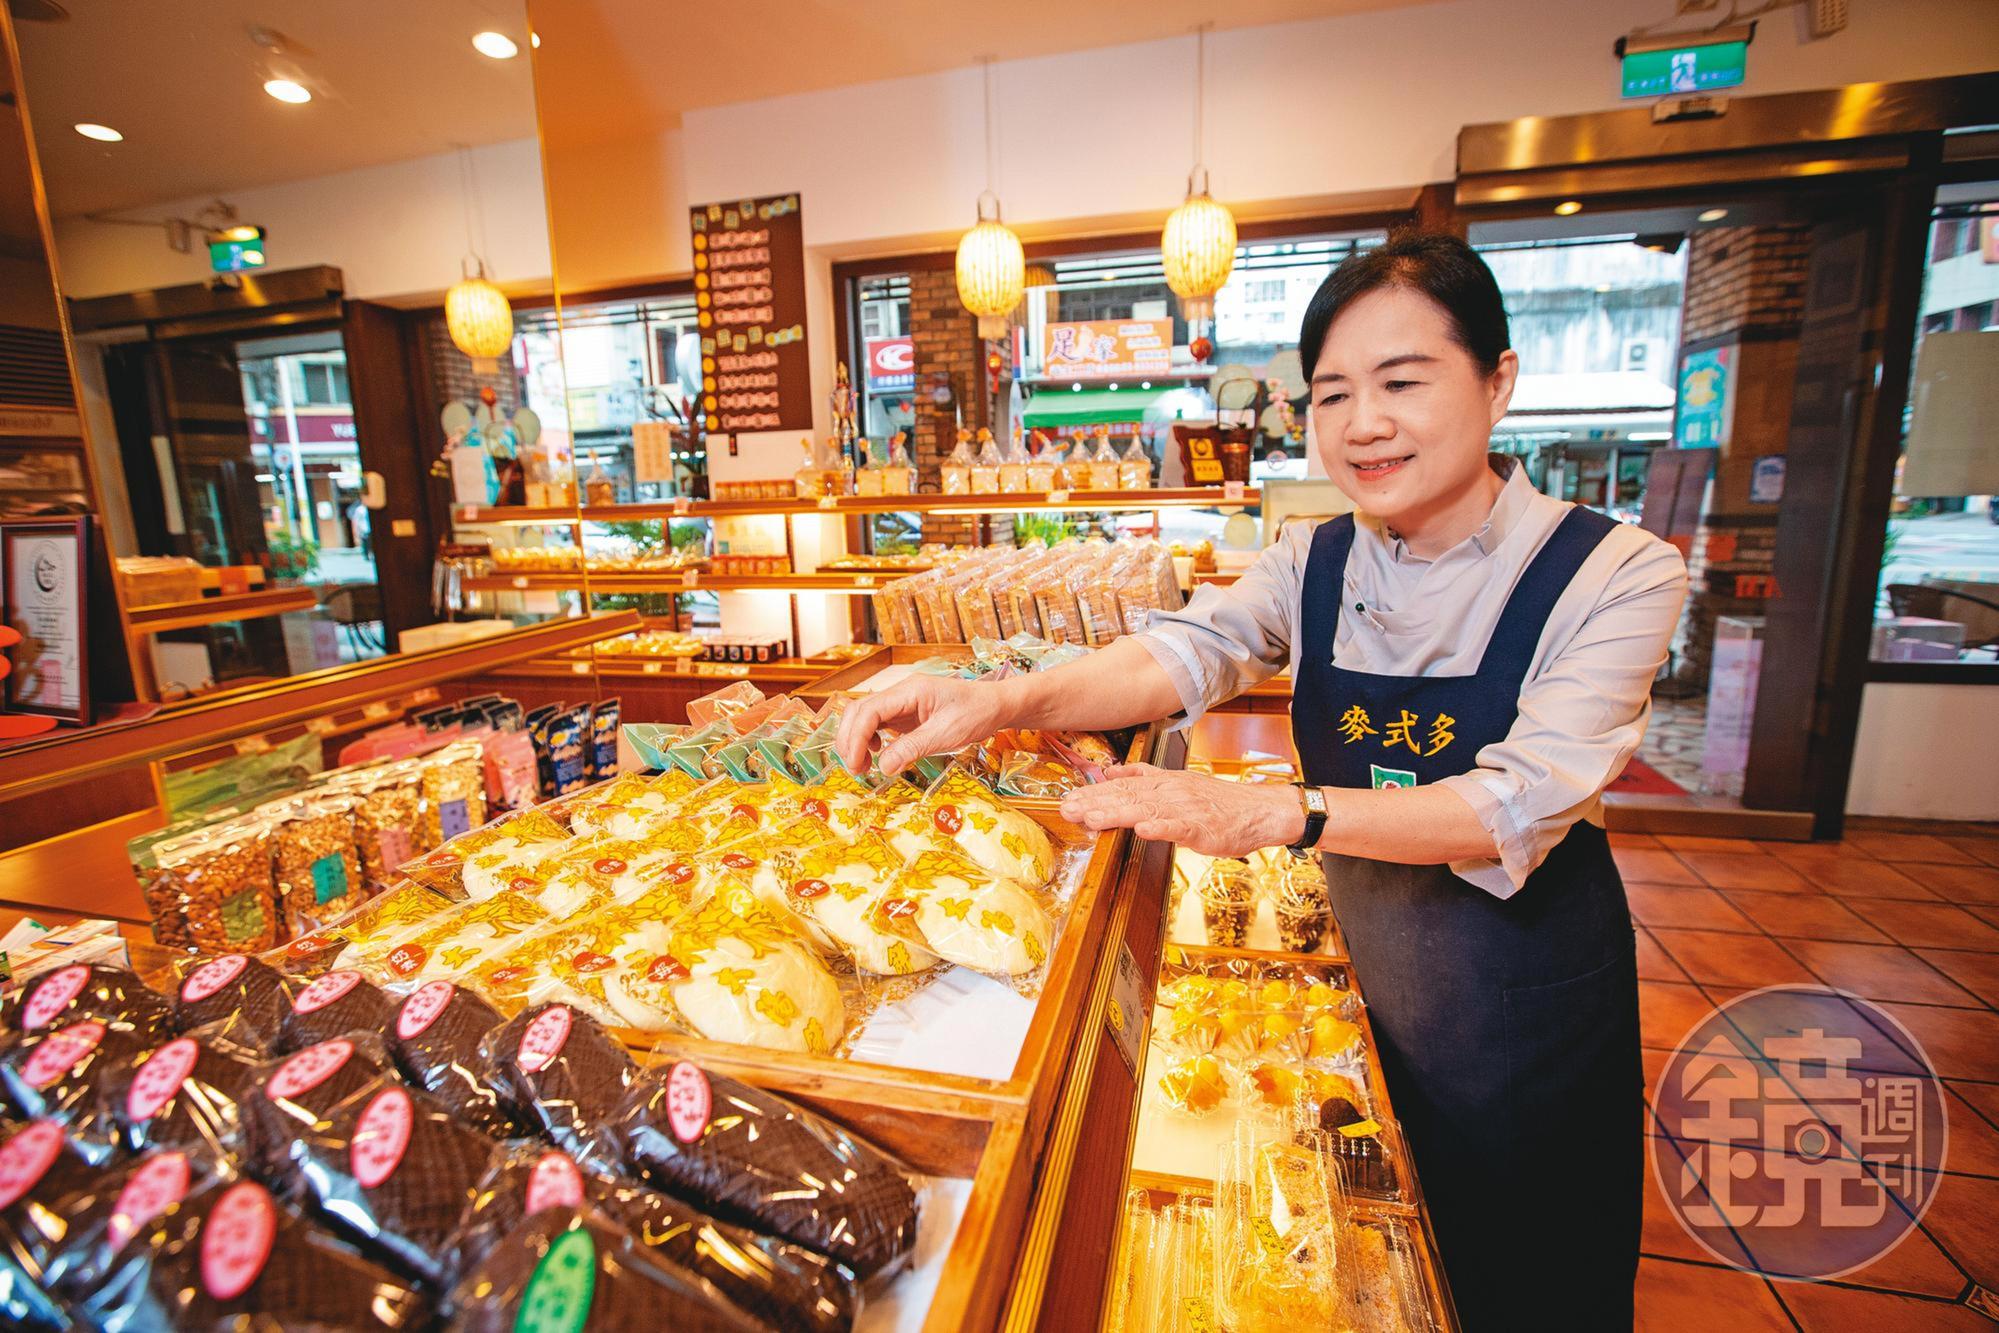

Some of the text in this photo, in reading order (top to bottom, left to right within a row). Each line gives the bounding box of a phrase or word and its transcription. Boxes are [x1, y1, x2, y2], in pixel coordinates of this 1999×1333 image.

[1337, 705, 1456, 757] 麥式多
[937, 809, 961, 832] 奶素
[390, 949, 418, 972] 奶素
